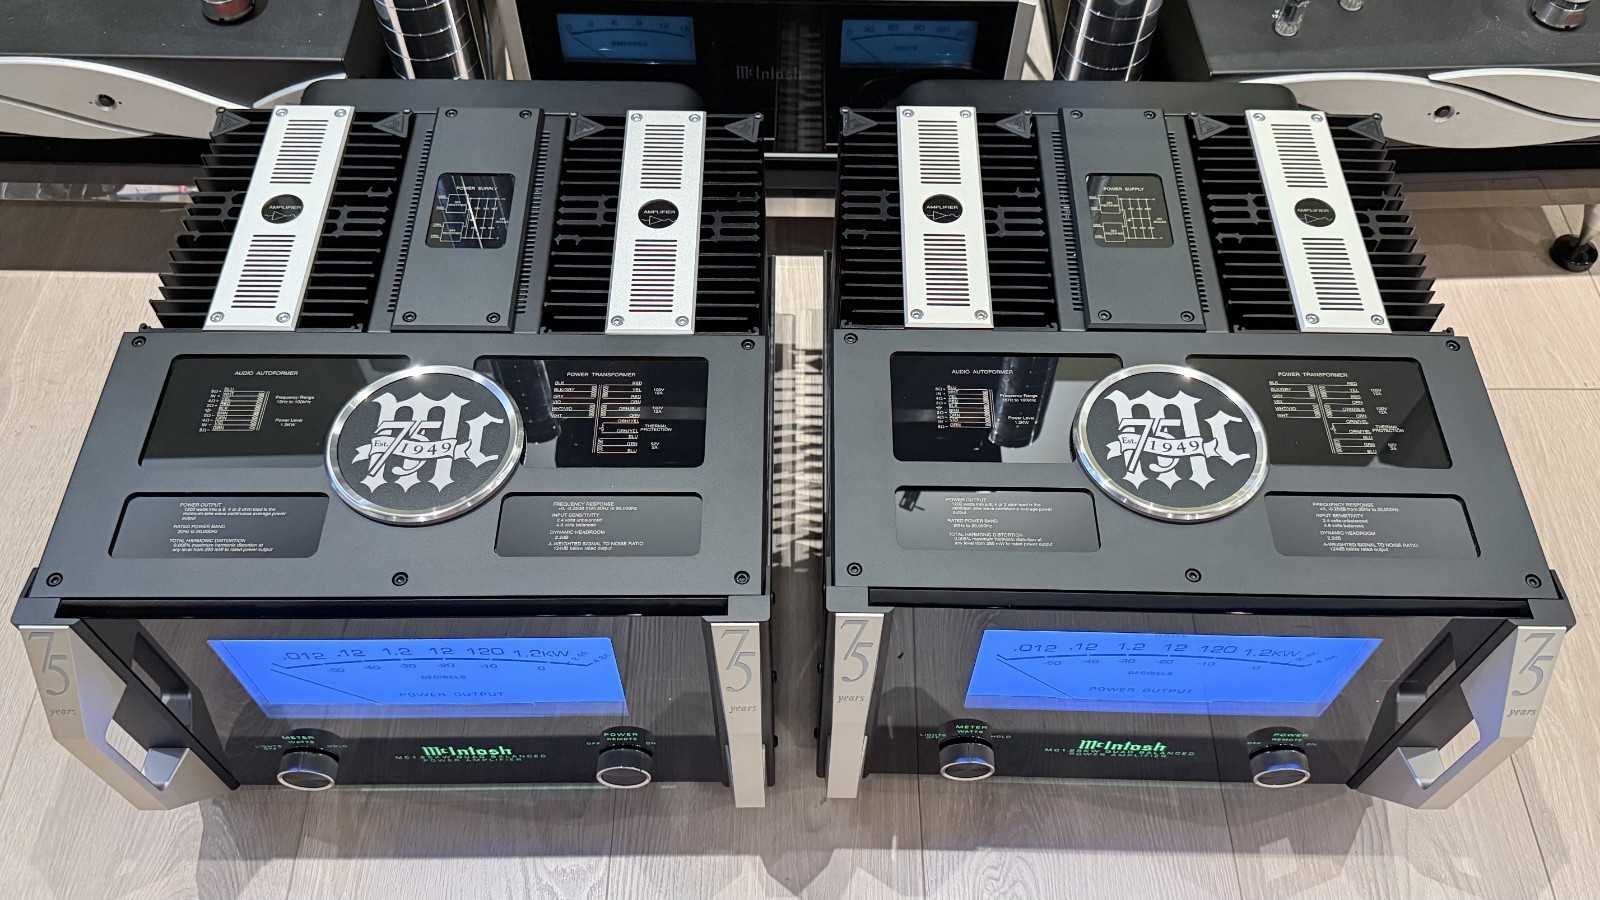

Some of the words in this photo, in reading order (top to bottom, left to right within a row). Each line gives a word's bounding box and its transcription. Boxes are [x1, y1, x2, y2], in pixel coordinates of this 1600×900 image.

[367, 421, 443, 478] 75
[373, 439, 389, 448] Est.
[401, 442, 452, 456] 1949
[1118, 417, 1181, 474] 75
[1122, 437, 1137, 445] Est.
[1150, 440, 1200, 453] 1949
[283, 652, 326, 660] .012
[337, 649, 366, 657] .12
[382, 648, 413, 656] 1.2
[429, 647, 454, 655] 12
[466, 647, 505, 656] 120
[840, 619, 874, 683] 75
[1013, 643, 1057, 652] .012
[1069, 643, 1098, 651] .12
[1118, 642, 1146, 651] 1.2
[1164, 643, 1188, 652] 12
[1200, 645, 1238, 654] 120
[28, 631, 70, 696] 75
[720, 629, 756, 693] 75
[1511, 632, 1556, 697] 75
[837, 694, 865, 703] years
[49, 708, 77, 717] years
[729, 704, 757, 714] years
[1507, 709, 1537, 718] years
[421, 745, 512, 756] McIntosh
[1078, 739, 1167, 752] McIntosh
